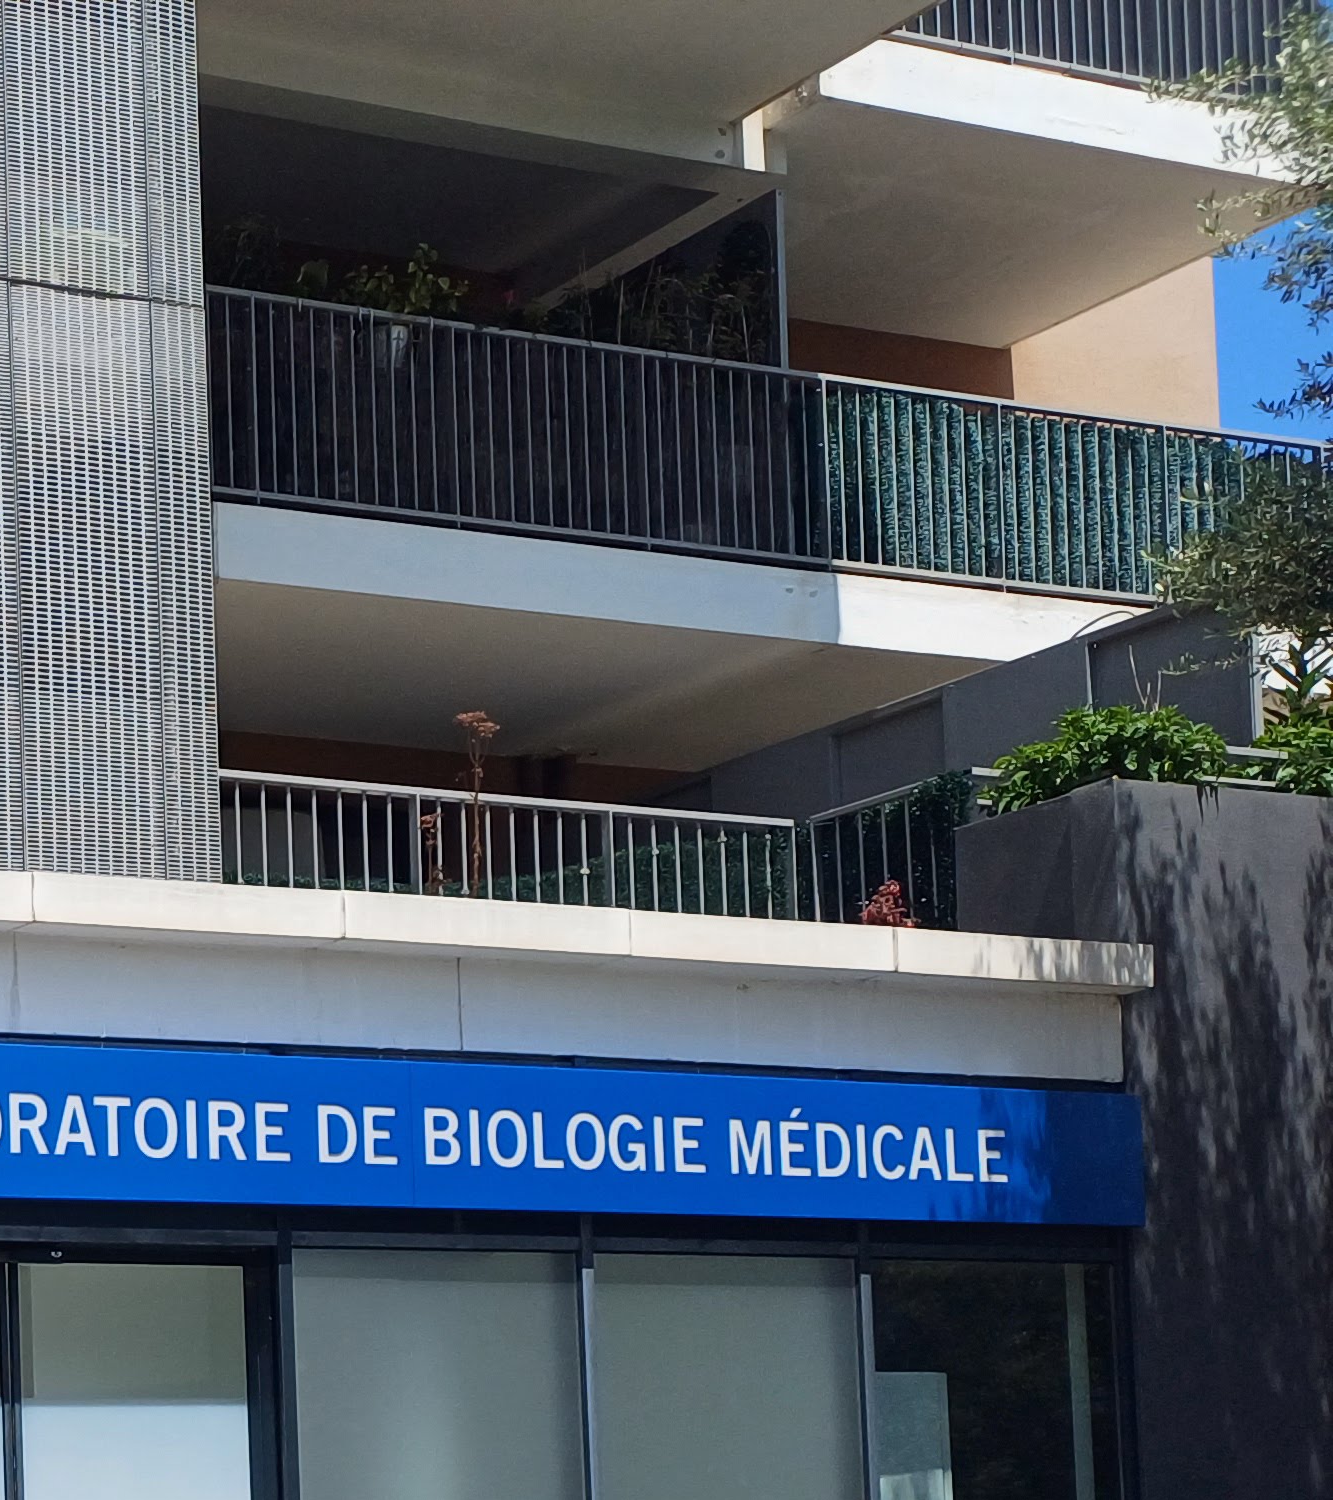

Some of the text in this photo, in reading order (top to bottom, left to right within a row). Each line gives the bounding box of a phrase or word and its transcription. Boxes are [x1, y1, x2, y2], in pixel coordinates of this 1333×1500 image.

[317, 1103, 399, 1166] DE
[423, 1106, 707, 1174] BIOLOGIE
[729, 1107, 1009, 1184] MÉDICALE
